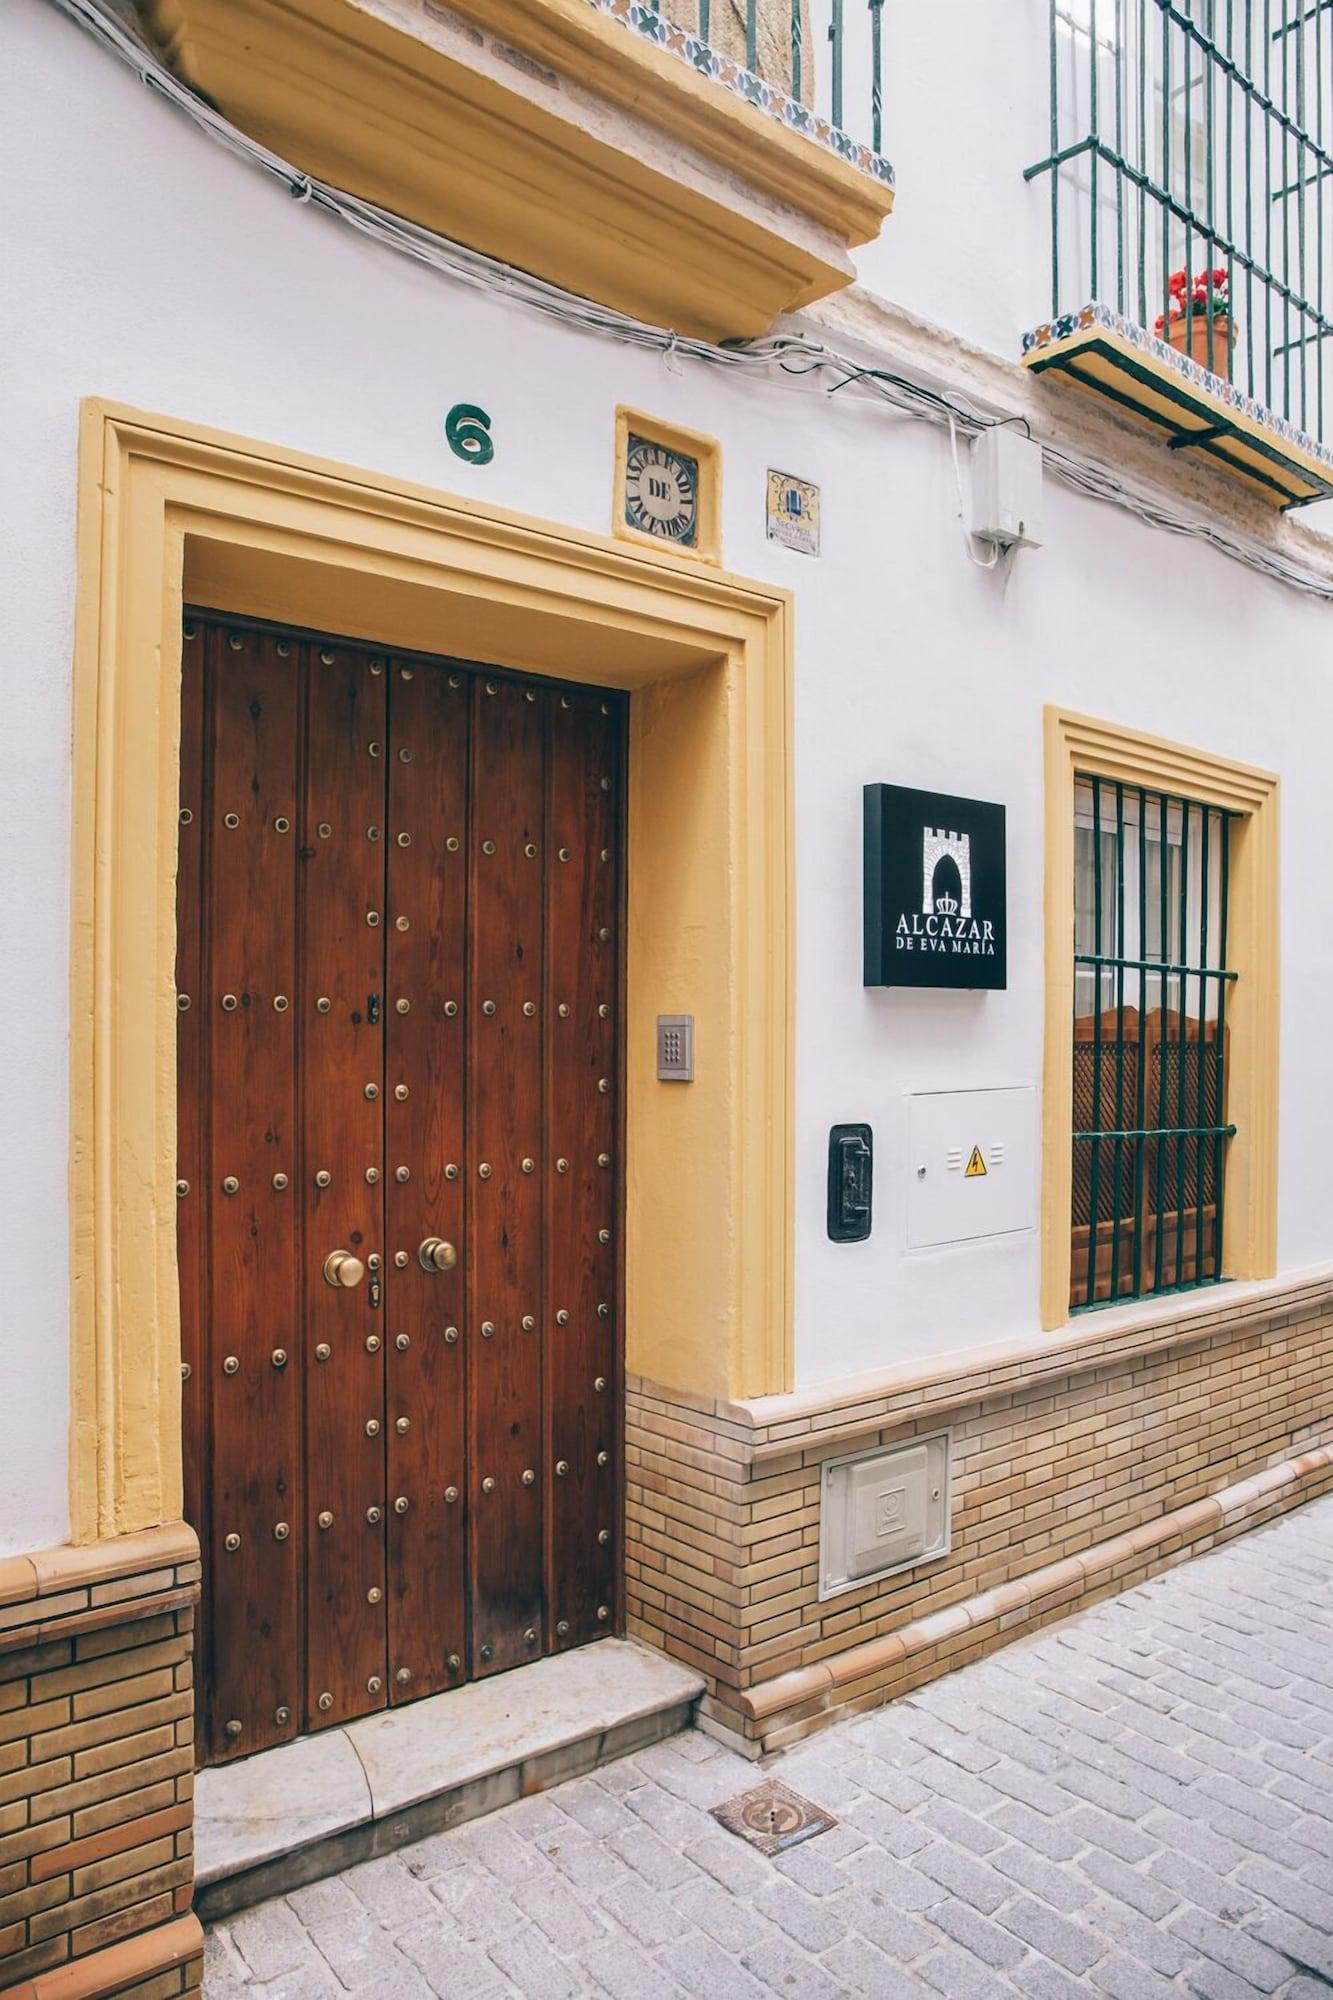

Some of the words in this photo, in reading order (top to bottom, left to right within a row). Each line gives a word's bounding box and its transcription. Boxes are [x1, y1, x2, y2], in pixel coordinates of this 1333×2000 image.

[445, 403, 494, 465] 6
[649, 478, 671, 502] DE
[896, 912, 995, 940] ALCAZAR
[896, 936, 914, 950] DE
[920, 938, 946, 952] EVA
[952, 939, 995, 955] MARÍA
